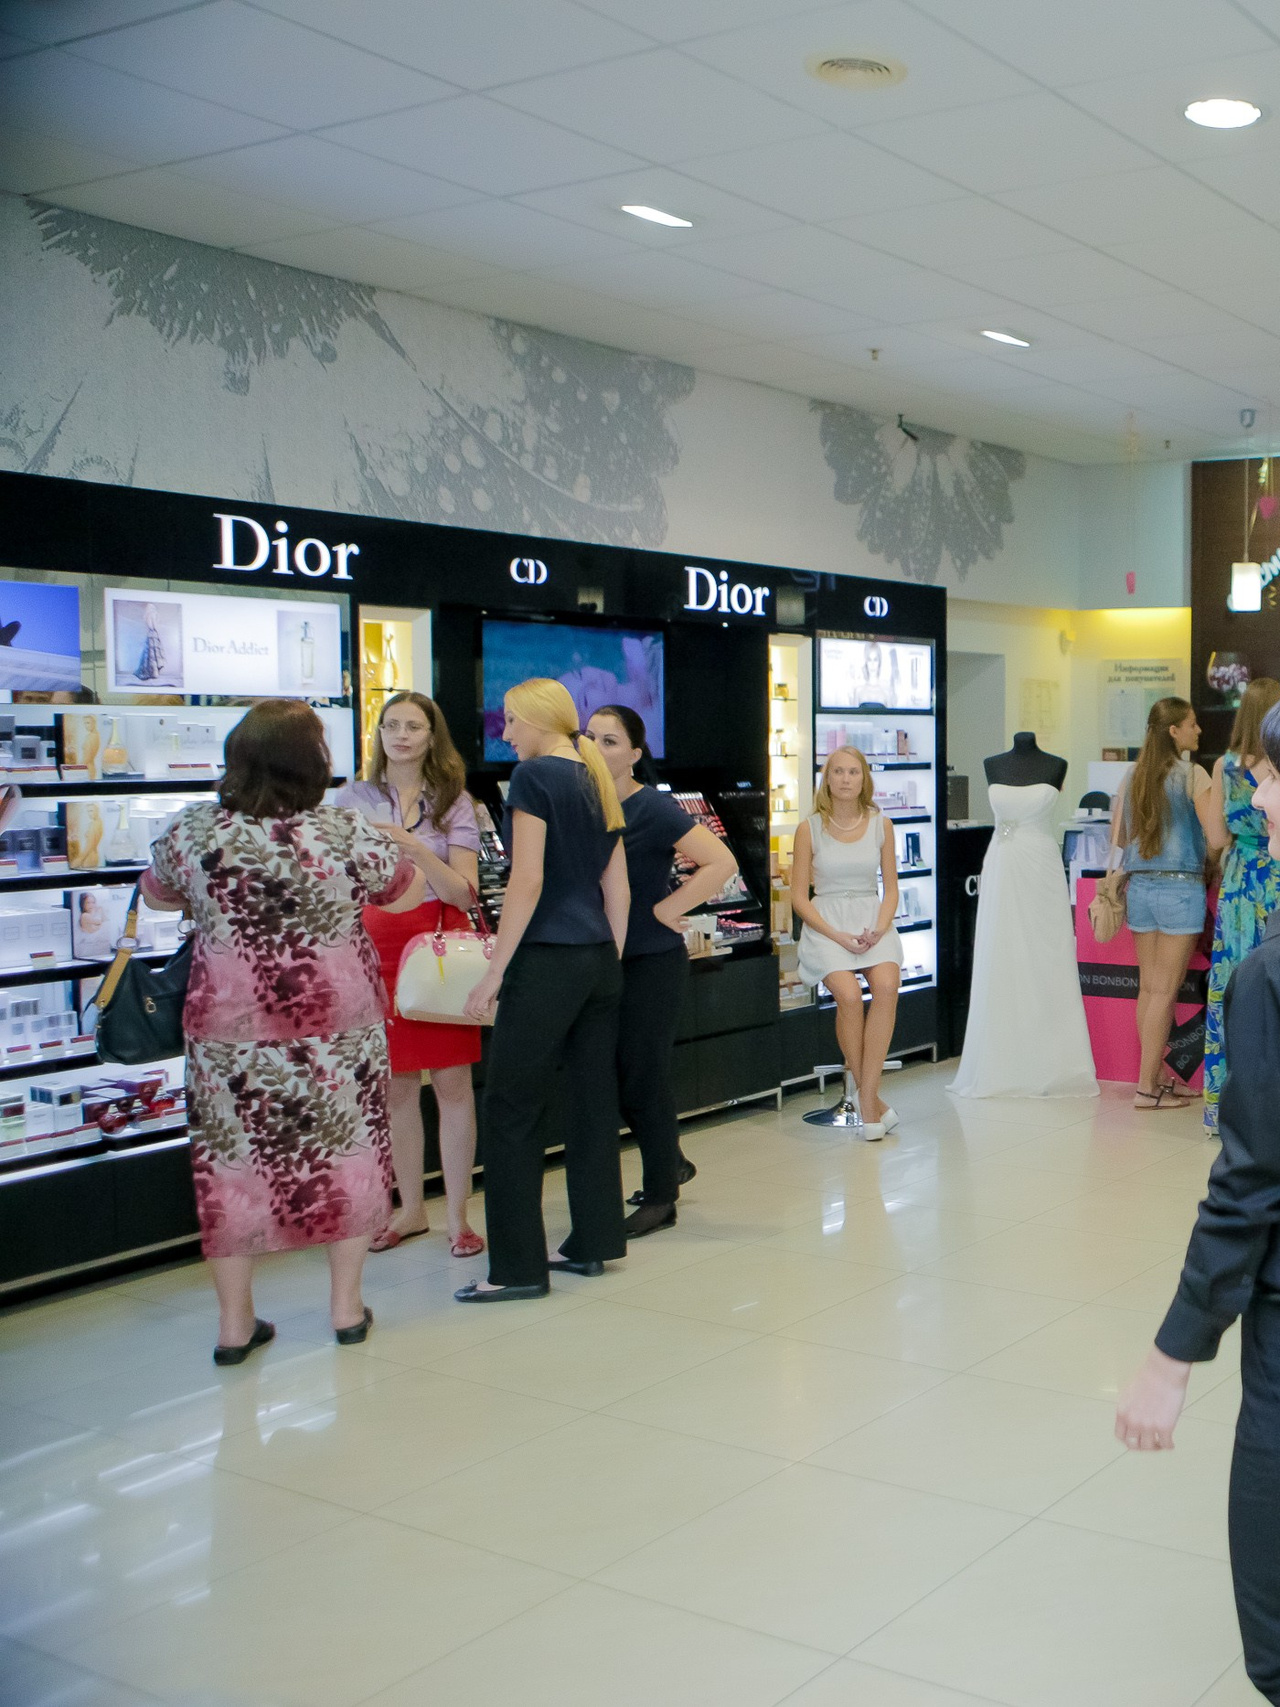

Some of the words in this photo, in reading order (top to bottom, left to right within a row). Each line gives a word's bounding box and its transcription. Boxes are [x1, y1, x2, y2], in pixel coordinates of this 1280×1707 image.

[212, 512, 360, 580] Dior
[683, 566, 770, 616] Dior
[193, 637, 226, 655] Dior
[227, 639, 270, 656] Addict
[1092, 975, 1139, 987] BONBON
